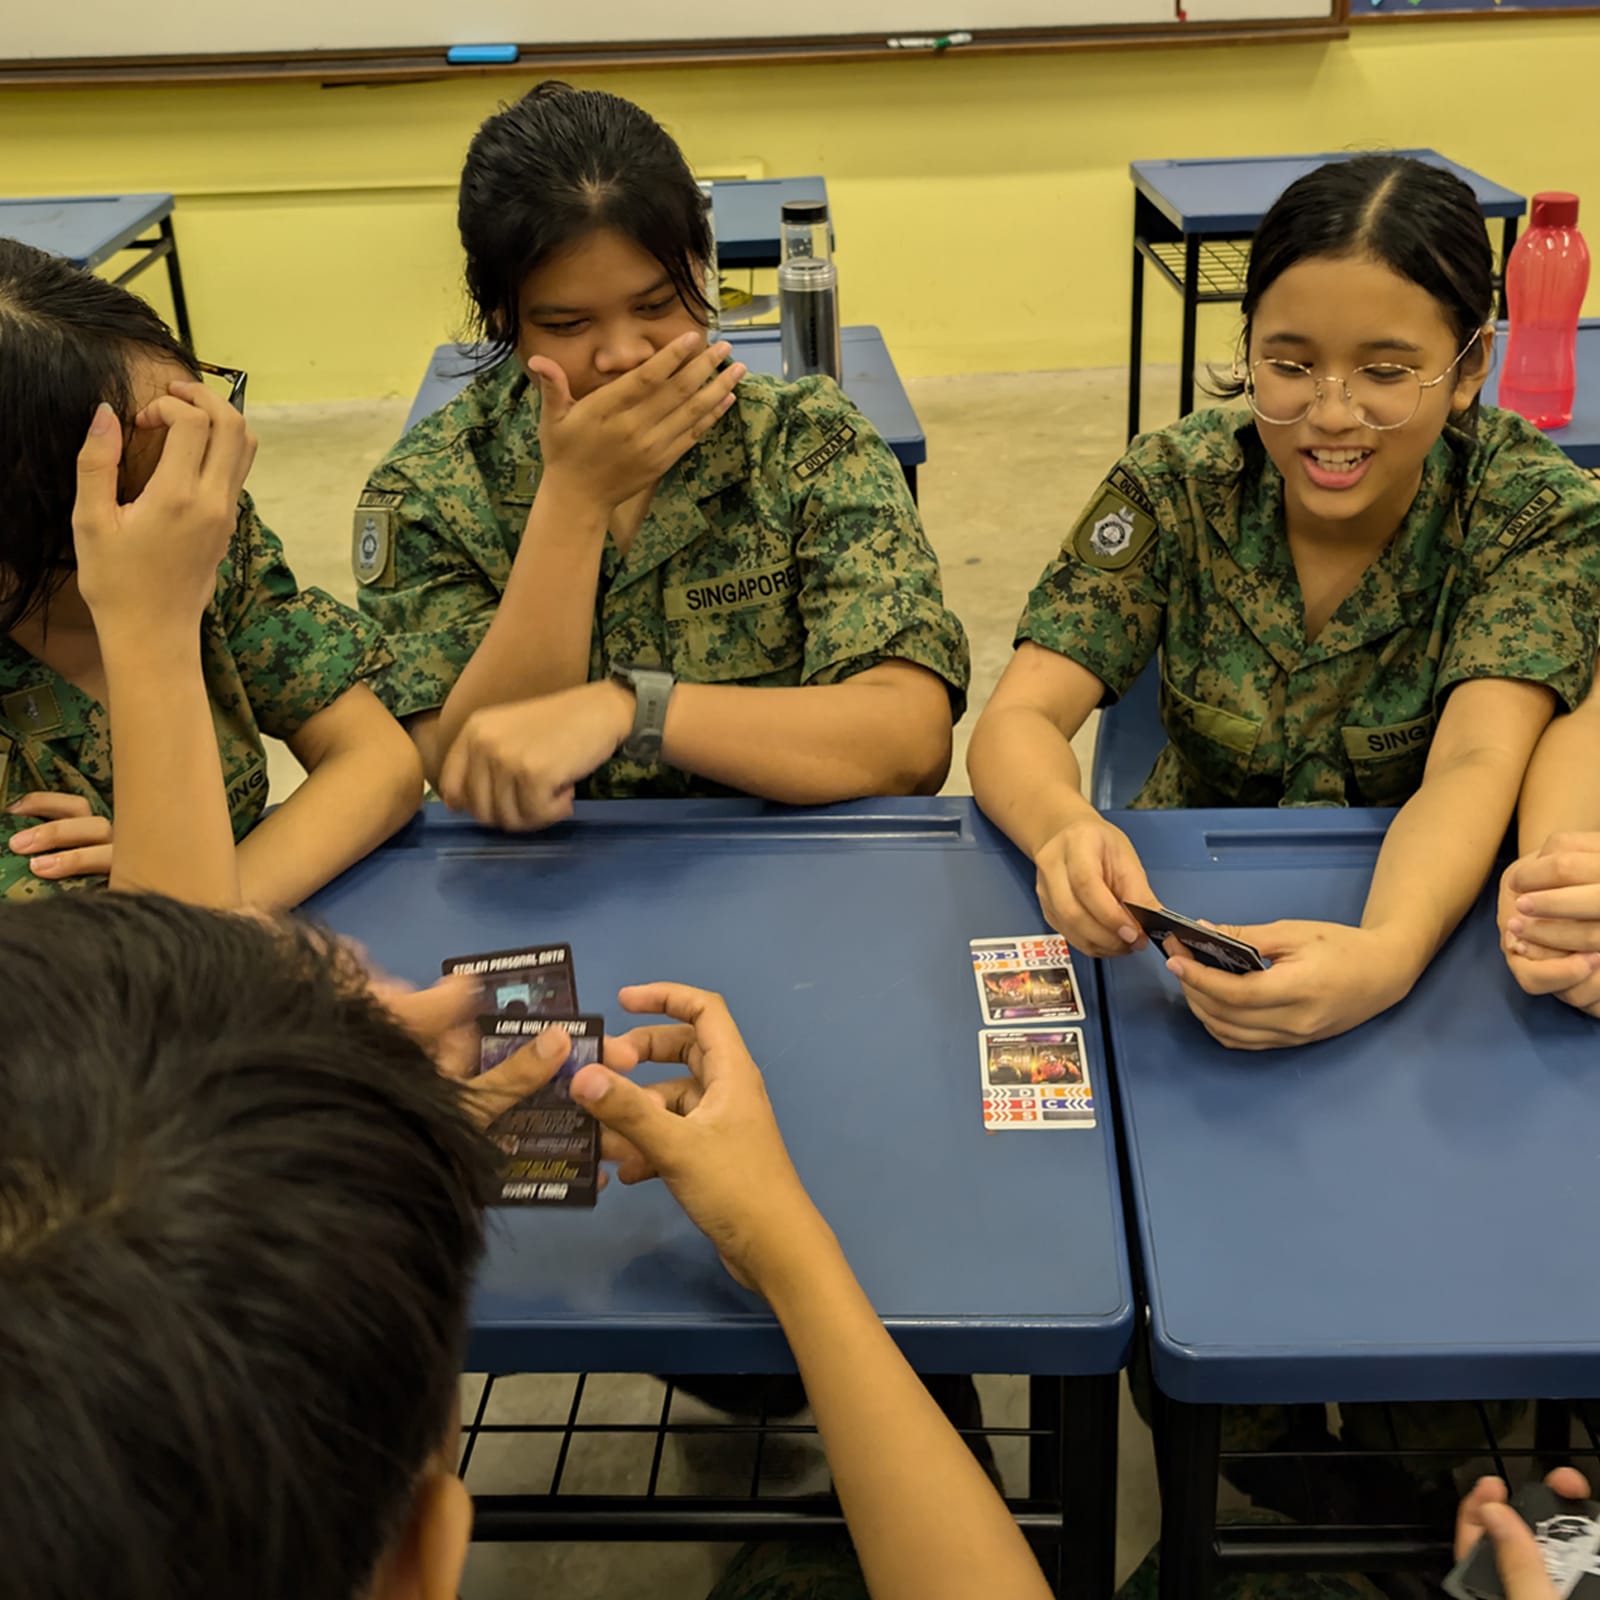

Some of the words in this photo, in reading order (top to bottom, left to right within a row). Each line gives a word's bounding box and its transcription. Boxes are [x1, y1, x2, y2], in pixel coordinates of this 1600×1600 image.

[804, 434, 844, 471] OUTRAM
[1507, 495, 1549, 537] OUTRAM
[686, 565, 797, 611] SINGAPORE
[489, 953, 538, 972] PERSONAL
[538, 949, 566, 965] DATA
